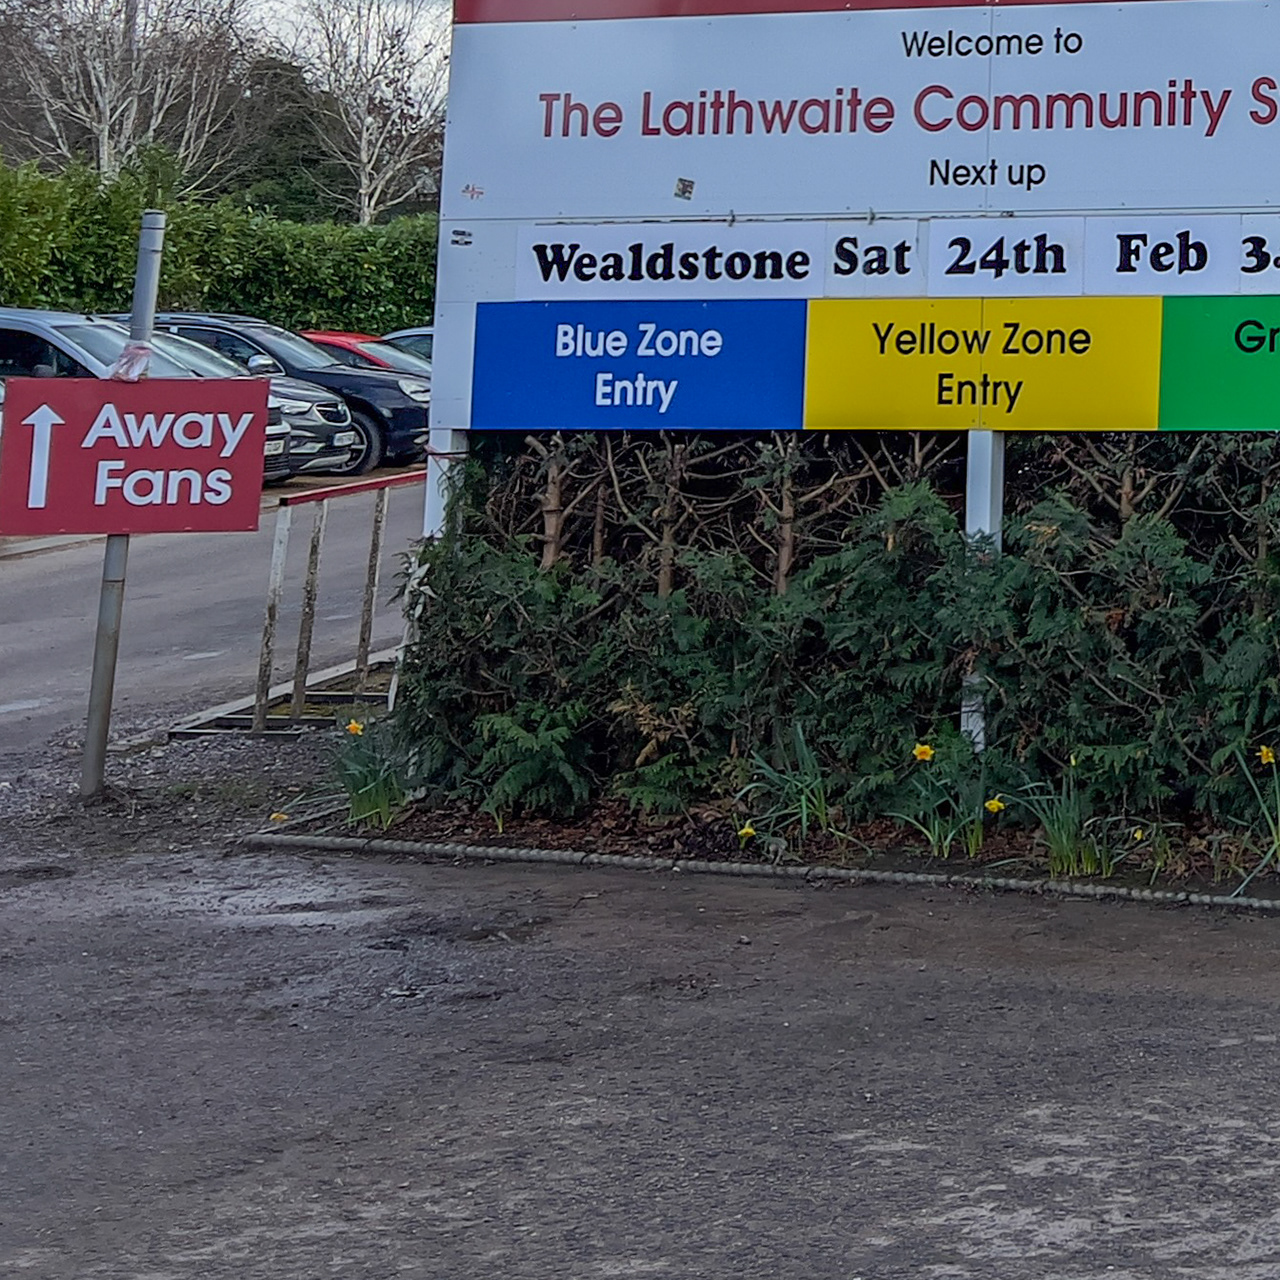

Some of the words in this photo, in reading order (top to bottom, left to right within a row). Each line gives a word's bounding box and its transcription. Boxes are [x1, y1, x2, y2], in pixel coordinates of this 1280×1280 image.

[902, 29, 1043, 59] Welcome
[1054, 27, 1083, 55] to
[539, 93, 622, 138] The
[641, 87, 895, 136] Laithwaite
[913, 79, 1231, 138] Community
[930, 158, 998, 187] Next
[1007, 162, 1046, 190] up
[533, 242, 810, 282] Wealdstone
[833, 237, 911, 276] Sat
[945, 233, 1066, 279] 24th
[1116, 230, 1207, 275] Feb
[555, 323, 627, 358] Blue
[638, 323, 722, 358] Zone
[872, 322, 990, 357] Yellow
[1002, 322, 1091, 356] Zone
[595, 373, 678, 413] Entry
[938, 373, 1023, 413] Entry
[81, 403, 254, 458] Away
[94, 460, 232, 506] Fans
